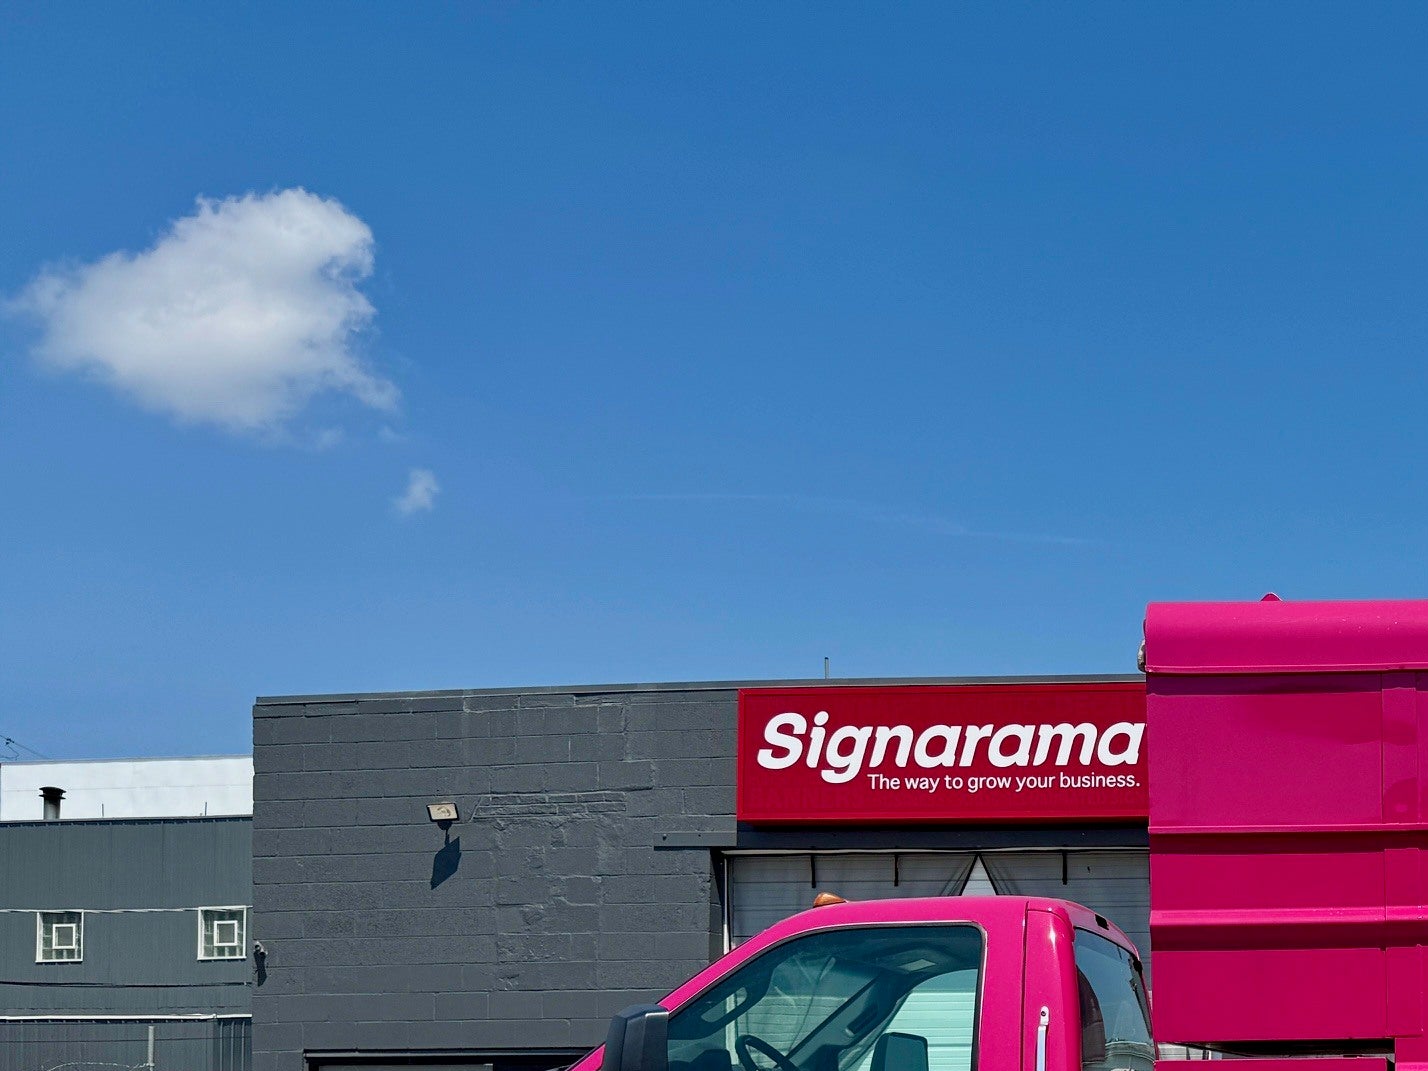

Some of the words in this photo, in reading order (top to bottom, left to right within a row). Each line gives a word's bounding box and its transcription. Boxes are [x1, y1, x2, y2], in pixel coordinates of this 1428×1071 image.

[756, 710, 1145, 784] Signarama
[867, 773, 900, 789] The
[904, 777, 940, 793] way
[944, 774, 963, 789] to
[967, 776, 1012, 793] grow
[1015, 776, 1055, 792] your
[1059, 771, 1141, 788] business.
